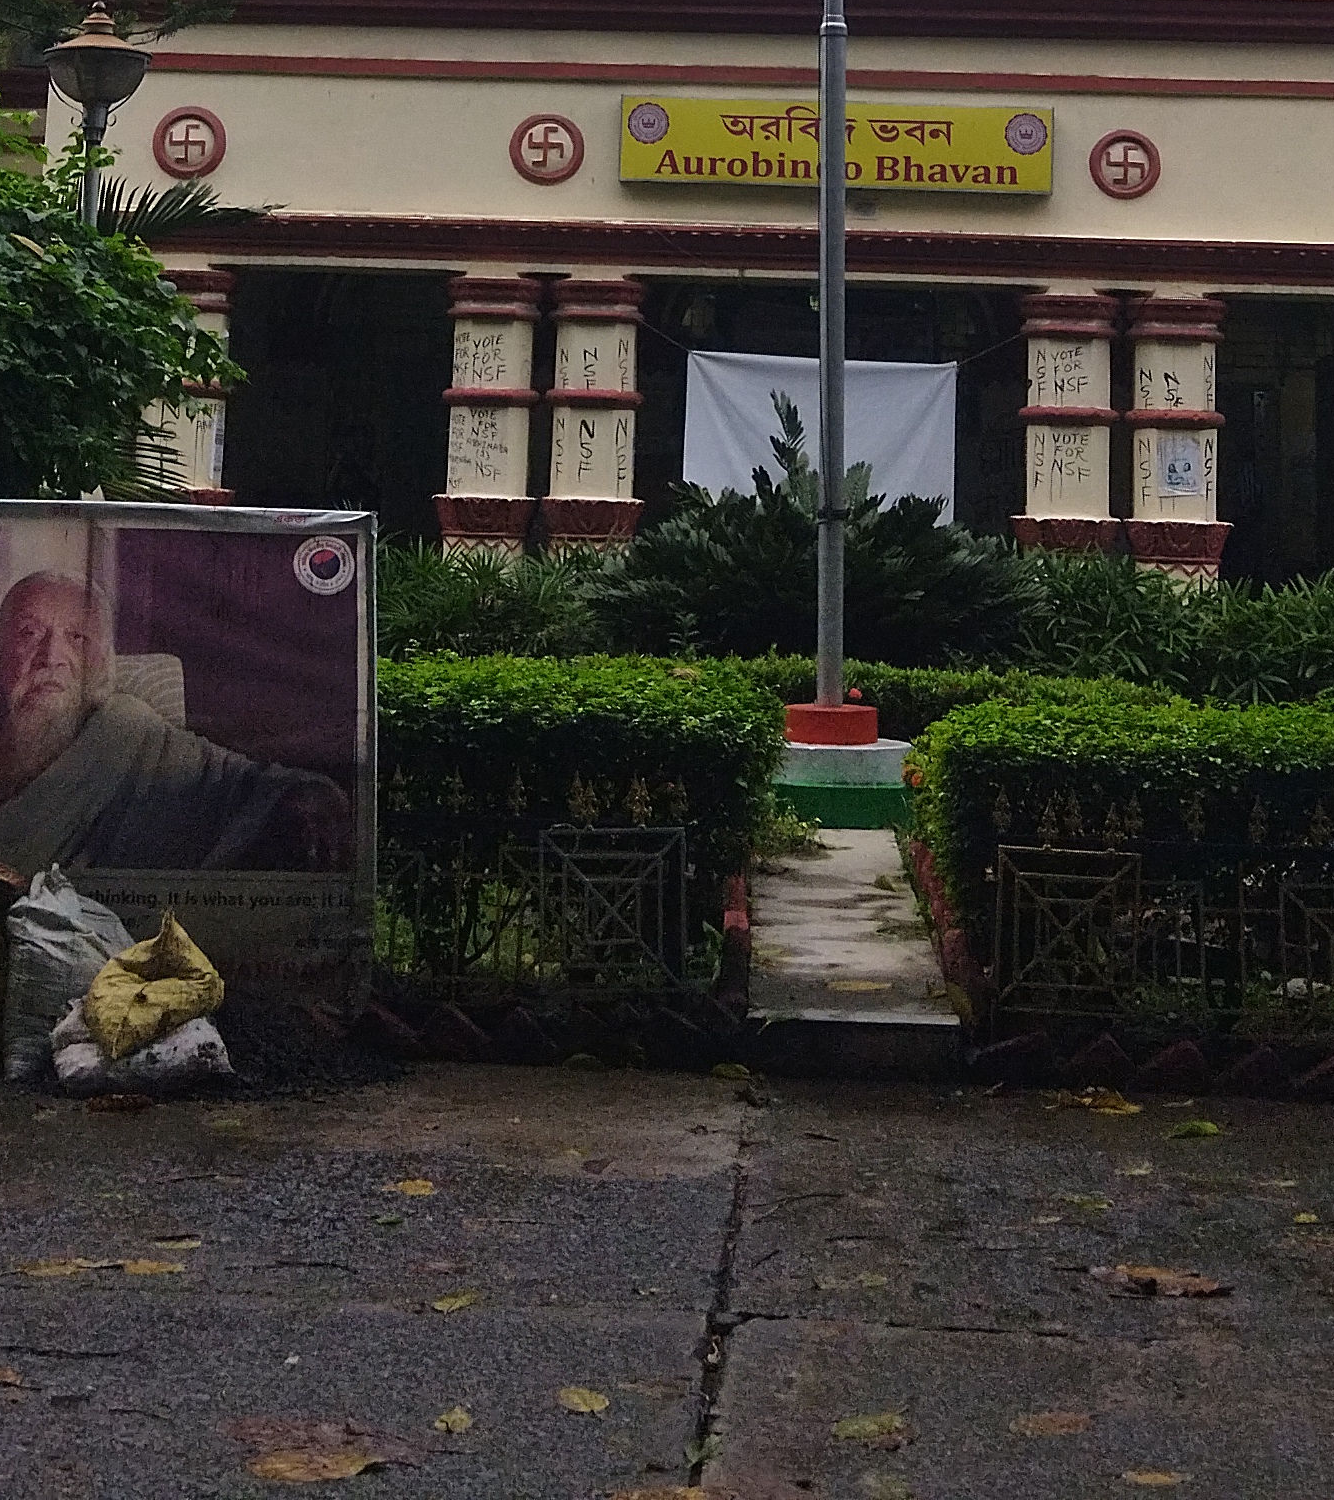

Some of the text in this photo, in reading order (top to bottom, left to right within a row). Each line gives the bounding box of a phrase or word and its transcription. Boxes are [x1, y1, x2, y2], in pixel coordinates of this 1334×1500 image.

[867, 117, 955, 148] ভবন
[654, 149, 1019, 186] Aurobino Bhavan
[472, 334, 505, 349] VOTE
[472, 349, 506, 365] FOR
[1051, 346, 1083, 361] VOTE
[472, 365, 506, 382] NSF
[583, 347, 599, 390] NSF
[1036, 348, 1047, 397] NSF
[1054, 361, 1083, 376] FOR
[1054, 376, 1089, 394] NSF
[1140, 368, 1154, 408] NSF
[470, 409, 498, 421] VOTE
[471, 426, 497, 440] NSF
[478, 420, 498, 431] FOR
[555, 418, 565, 481] NSF
[1052, 433, 1089, 446] VOTE
[578, 418, 596, 483] NSF
[1054, 446, 1088, 462] FOR
[475, 460, 502, 482] NSF
[1033, 432, 1045, 490] NSF
[1051, 458, 1091, 483] NSF
[1204, 438, 1214, 502] NSF
[1139, 438, 1152, 507] NSF
[184, 892, 197, 906] is
[202, 892, 244, 907] what
[249, 895, 280, 910] you
[321, 892, 333, 907] it
